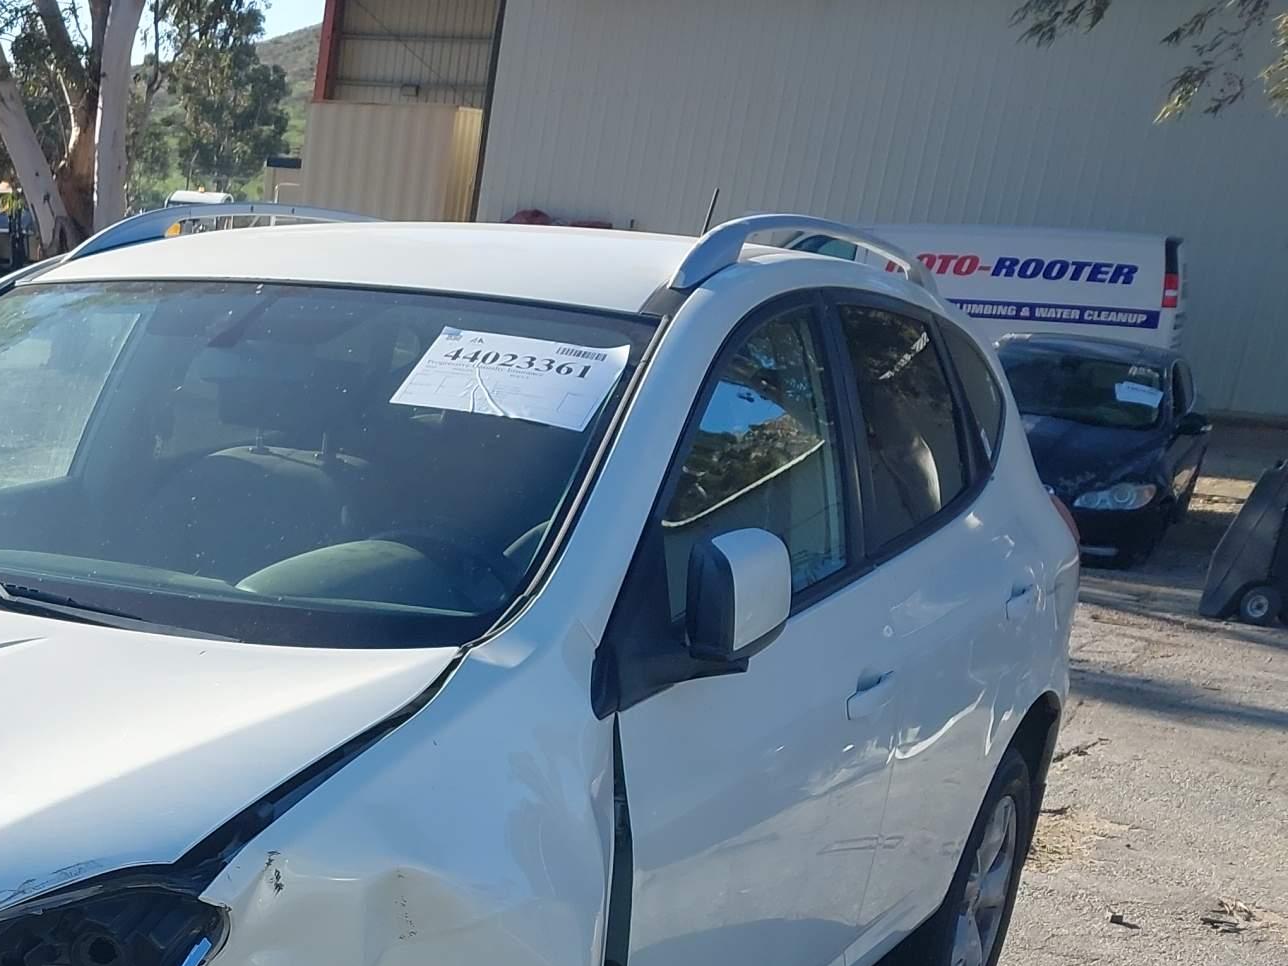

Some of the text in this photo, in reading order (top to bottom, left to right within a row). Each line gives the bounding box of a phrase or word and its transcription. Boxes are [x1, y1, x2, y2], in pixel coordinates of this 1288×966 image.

[1020, 306, 1030, 317] &
[1035, 307, 1080, 320] WATER
[1084, 310, 1147, 324] CLEANUP
[444, 347, 592, 379] 44023361
